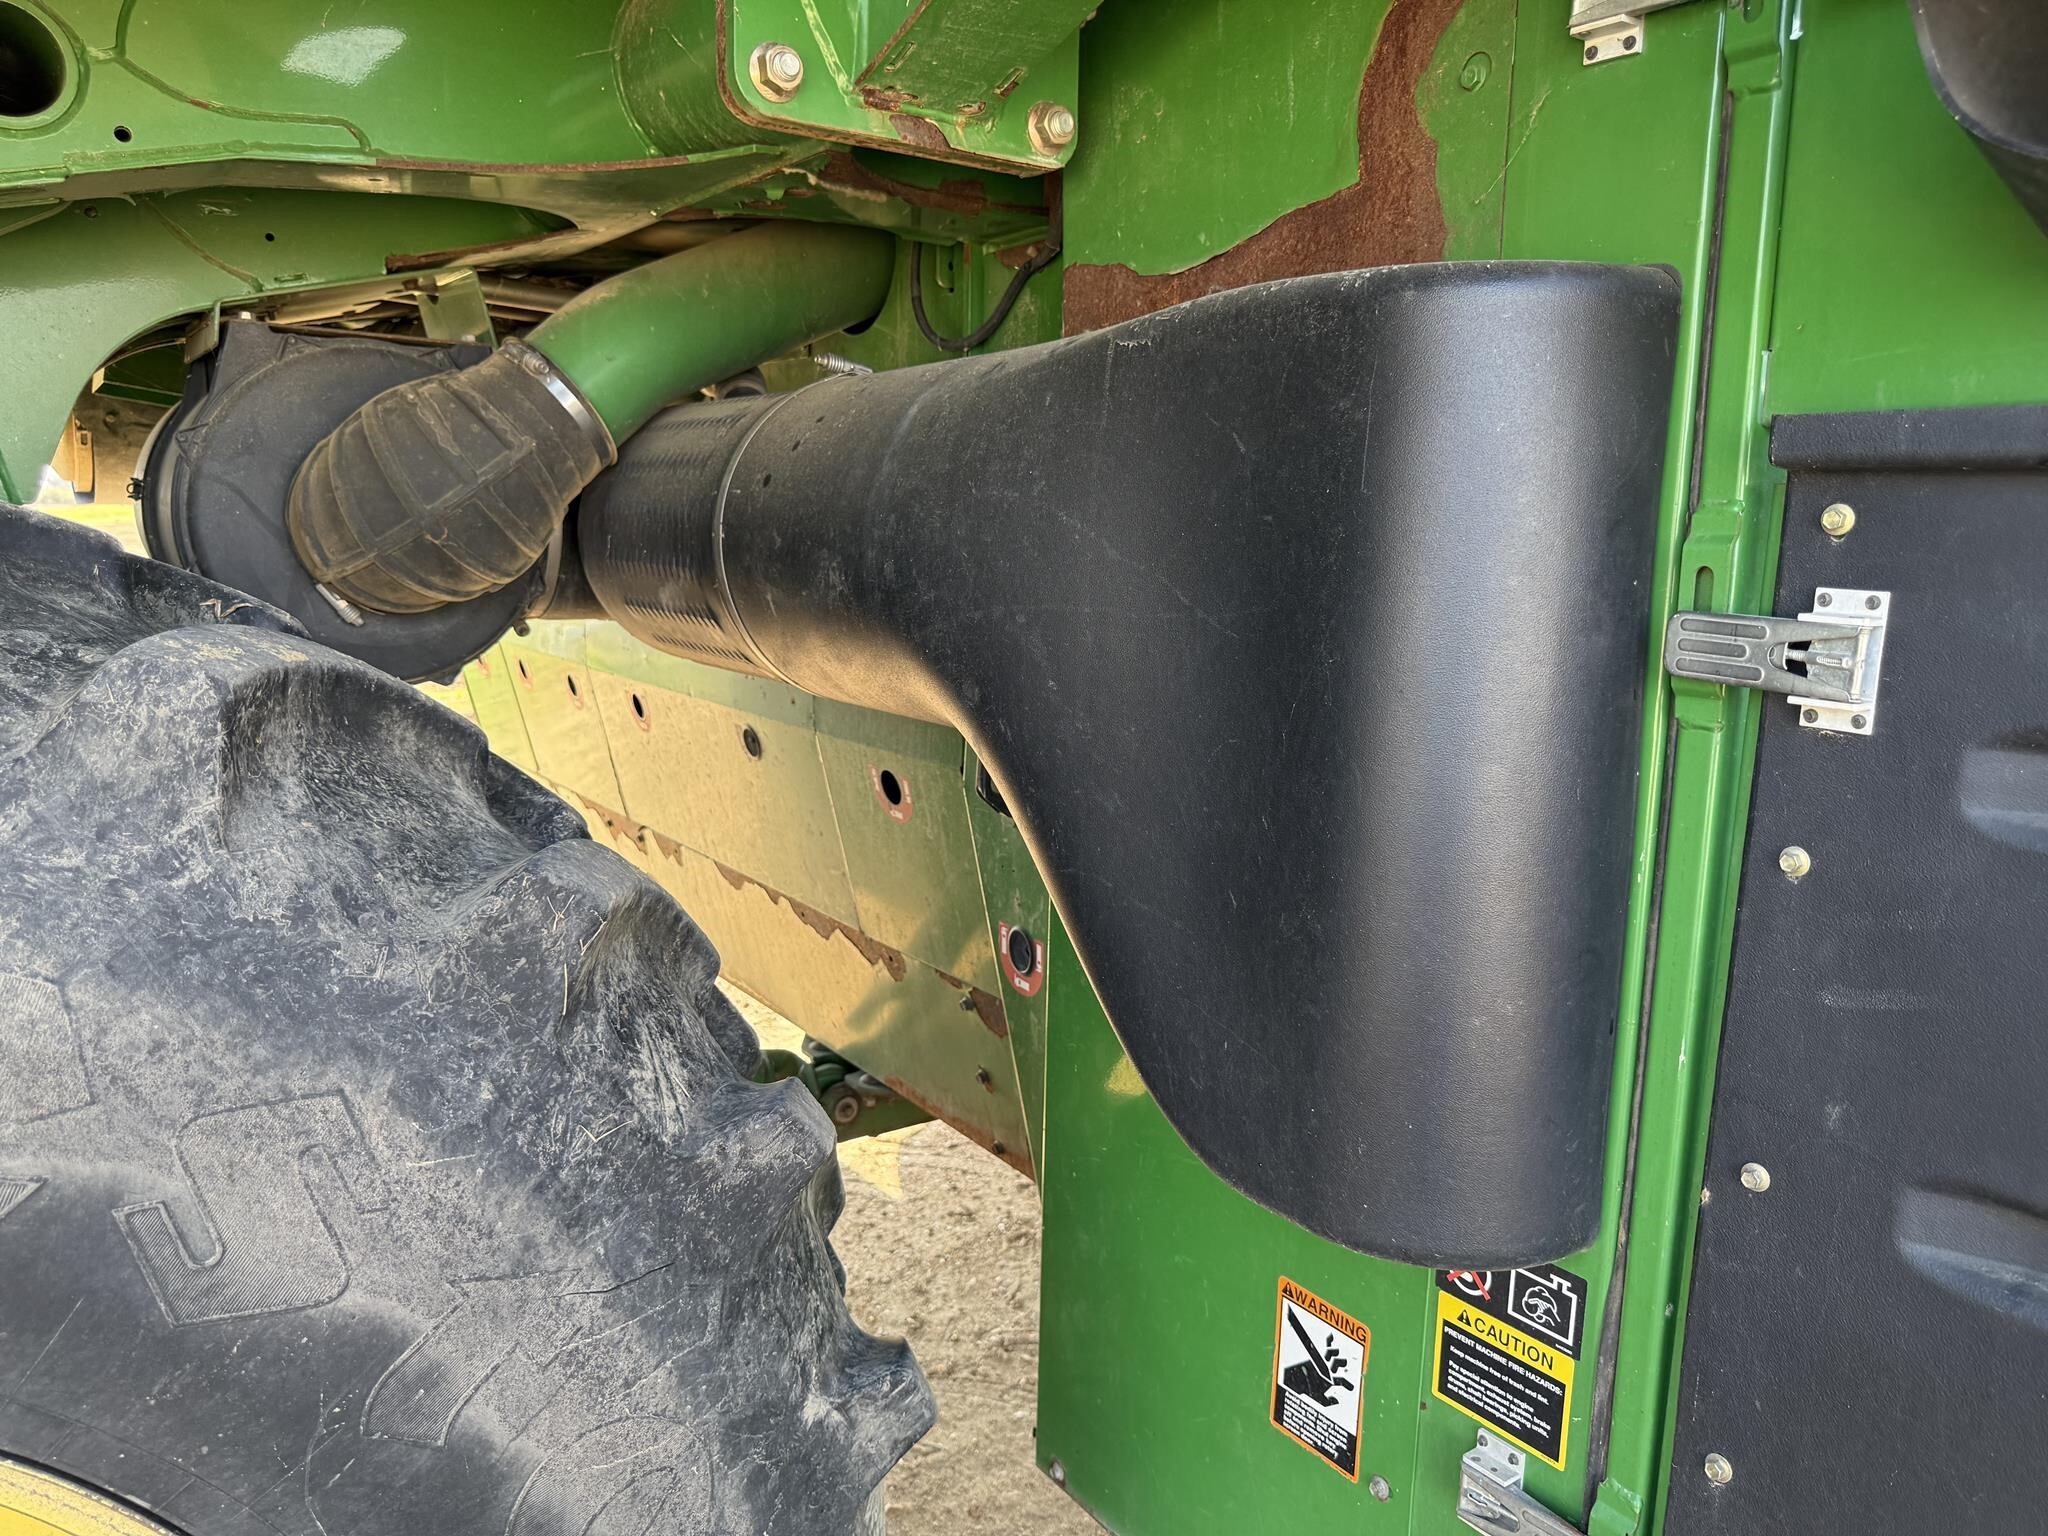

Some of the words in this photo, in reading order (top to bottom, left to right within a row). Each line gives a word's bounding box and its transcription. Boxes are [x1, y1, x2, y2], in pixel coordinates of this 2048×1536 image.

[1294, 1286, 1367, 1344] WARNING
[1444, 1326, 1475, 1347] PREVENT
[1476, 1343, 1507, 1366] MACHINE
[1508, 1361, 1525, 1375] FIRE
[1526, 1369, 1563, 1396] HAZARDS:
[1474, 1318, 1554, 1370] CAUTION
[1450, 1346, 1465, 1358] Keep
[1465, 1354, 1489, 1370] machine
[1525, 1387, 1537, 1398] and
[1460, 1367, 1480, 1382] special
[1480, 1379, 1505, 1396] attention
